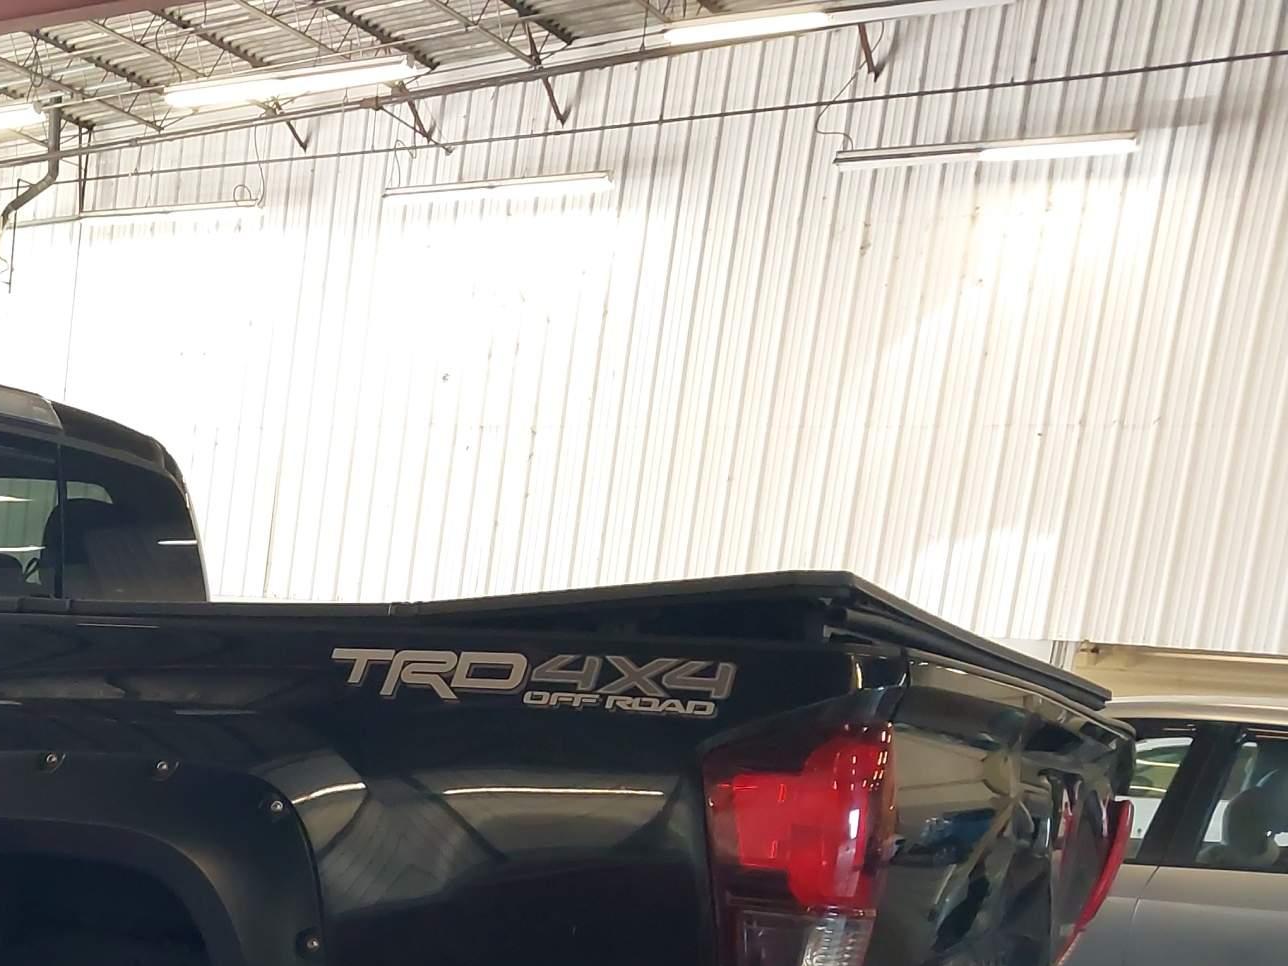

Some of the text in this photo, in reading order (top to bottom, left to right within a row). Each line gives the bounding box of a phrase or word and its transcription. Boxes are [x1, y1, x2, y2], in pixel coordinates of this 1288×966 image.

[331, 648, 528, 701] TRD
[522, 691, 718, 718] OFF ROAD
